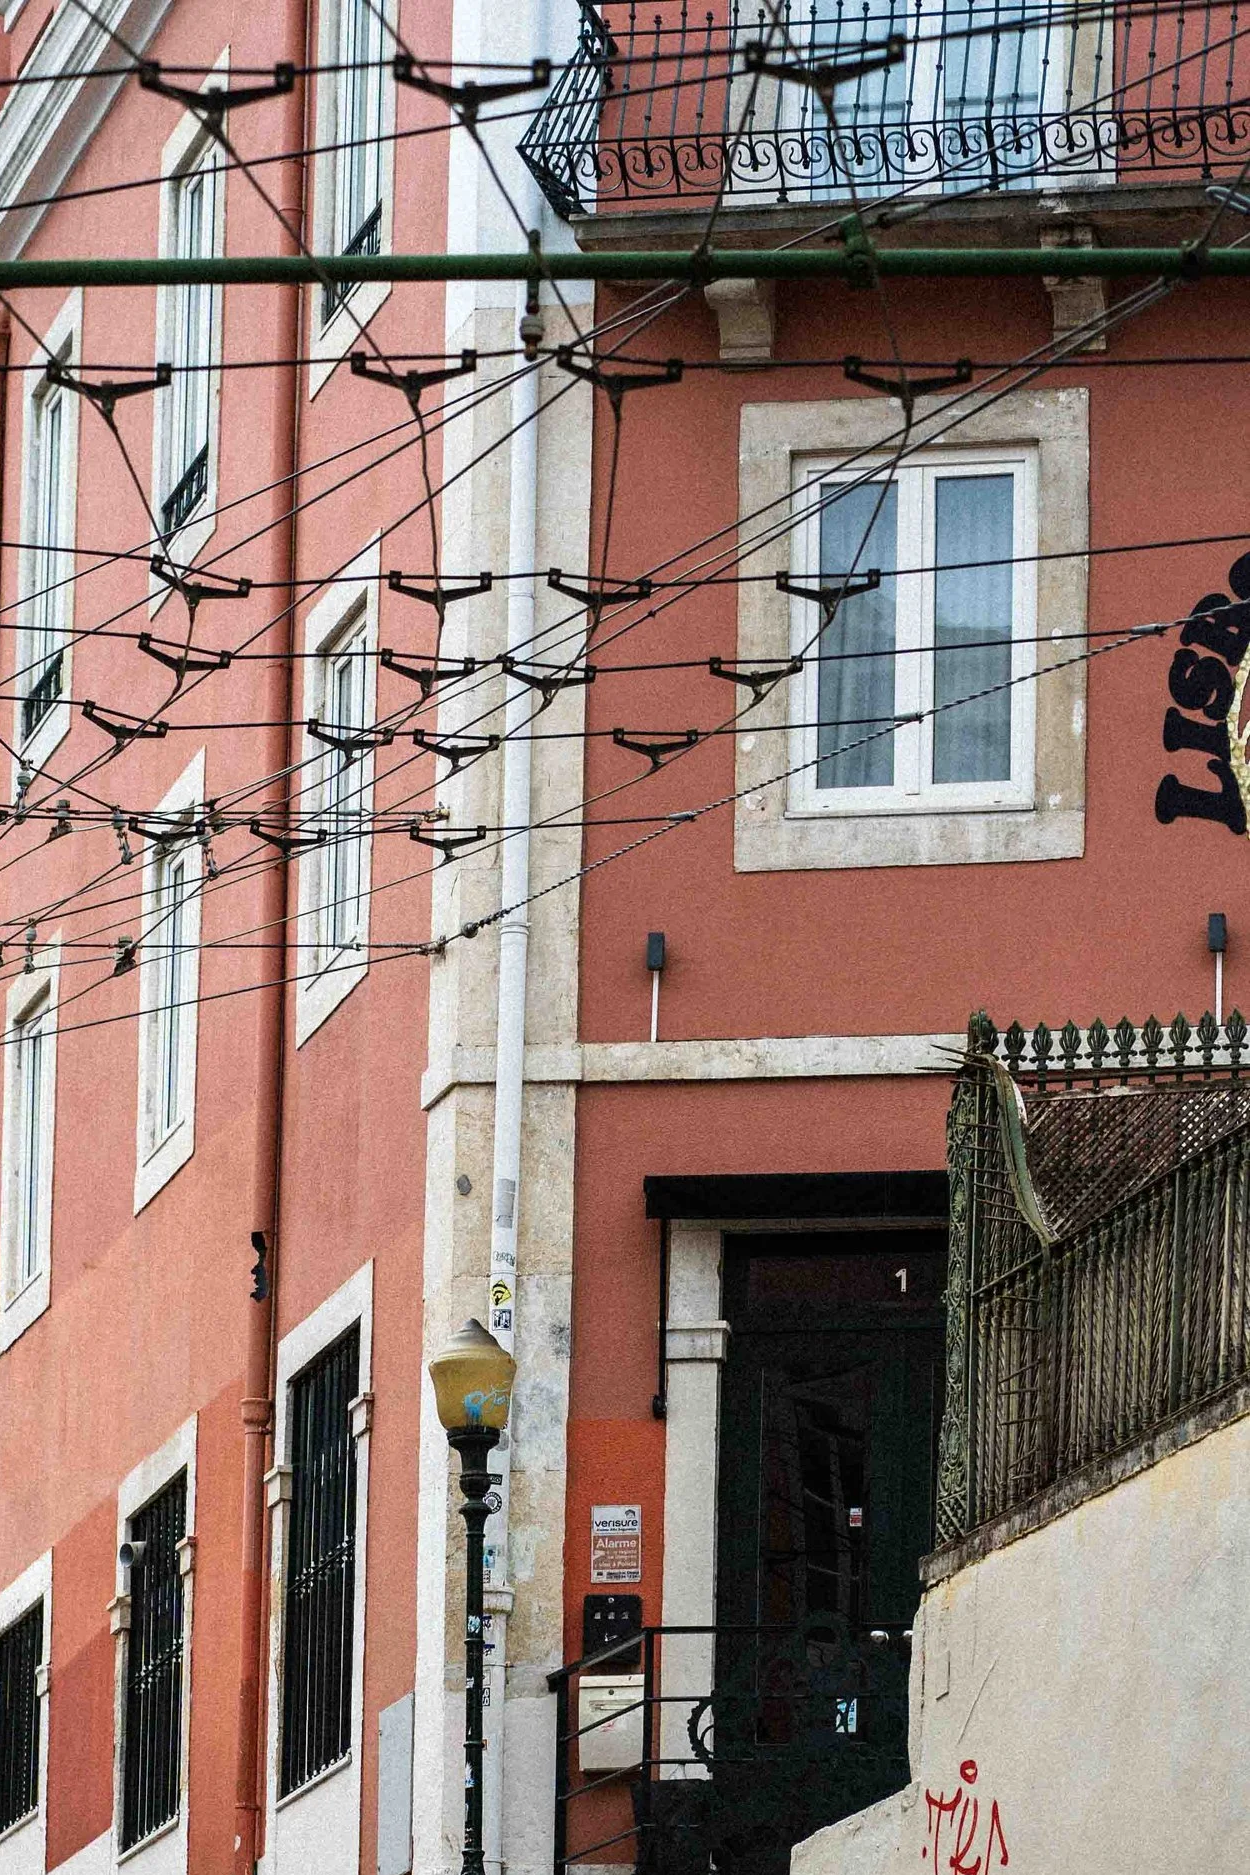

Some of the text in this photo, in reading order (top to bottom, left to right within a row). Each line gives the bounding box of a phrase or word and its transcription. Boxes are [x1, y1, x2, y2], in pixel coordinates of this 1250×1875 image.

[895, 1268, 907, 1292] 1
[595, 1520, 638, 1528] verisure
[596, 1538, 637, 1548] Alarme
